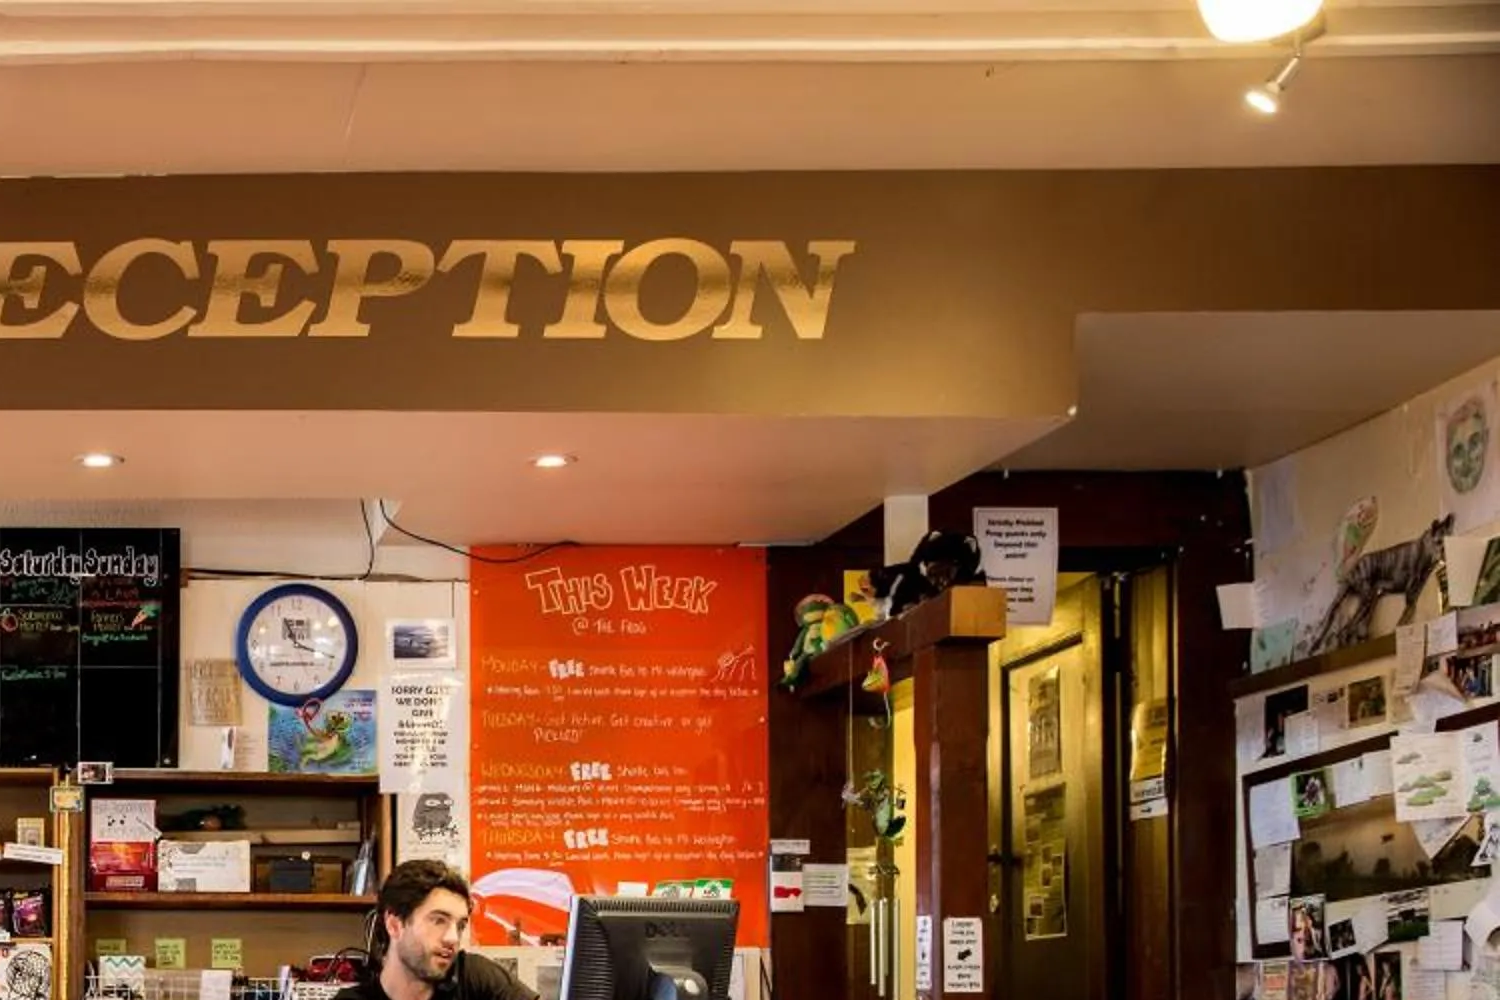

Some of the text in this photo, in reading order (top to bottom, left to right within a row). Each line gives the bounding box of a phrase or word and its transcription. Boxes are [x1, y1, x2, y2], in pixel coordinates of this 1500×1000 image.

[0, 546, 81, 585] Saturday
[82, 546, 159, 586] Sunday
[620, 564, 718, 614] WEEK
[570, 761, 613, 781] FREE
[563, 828, 610, 849] FREE
